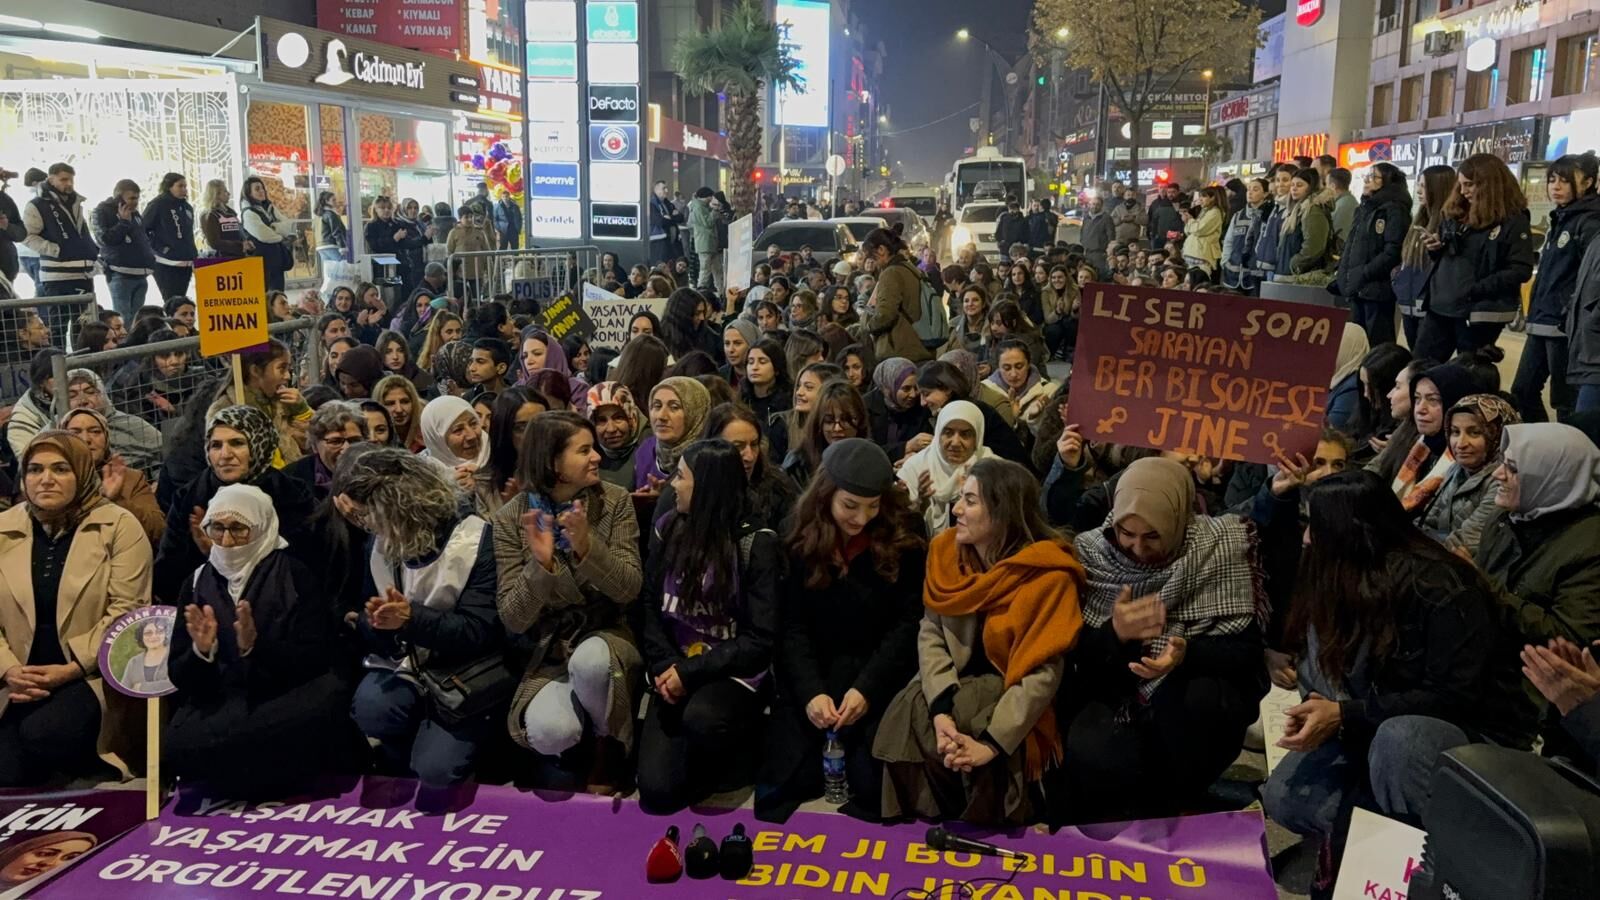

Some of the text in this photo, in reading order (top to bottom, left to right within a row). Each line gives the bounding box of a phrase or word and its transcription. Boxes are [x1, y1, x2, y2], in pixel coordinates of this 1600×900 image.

[345, 8, 375, 19] KEBAP
[403, 10, 441, 21] KIYMALI
[346, 24, 378, 35] KANAT
[590, 96, 637, 110] DeFacto
[216, 272, 243, 291] BIJÎ
[209, 312, 258, 331] JINAN
[193, 798, 509, 835] YAŞAMAK VE
[151, 826, 545, 873] YAŞATMAK İÇİN
[752, 831, 827, 854] EM
[840, 838, 887, 861] JI
[1002, 852, 1147, 884] BIJÎN
[1168, 857, 1207, 888] Û
[735, 863, 891, 897] BIDIN
